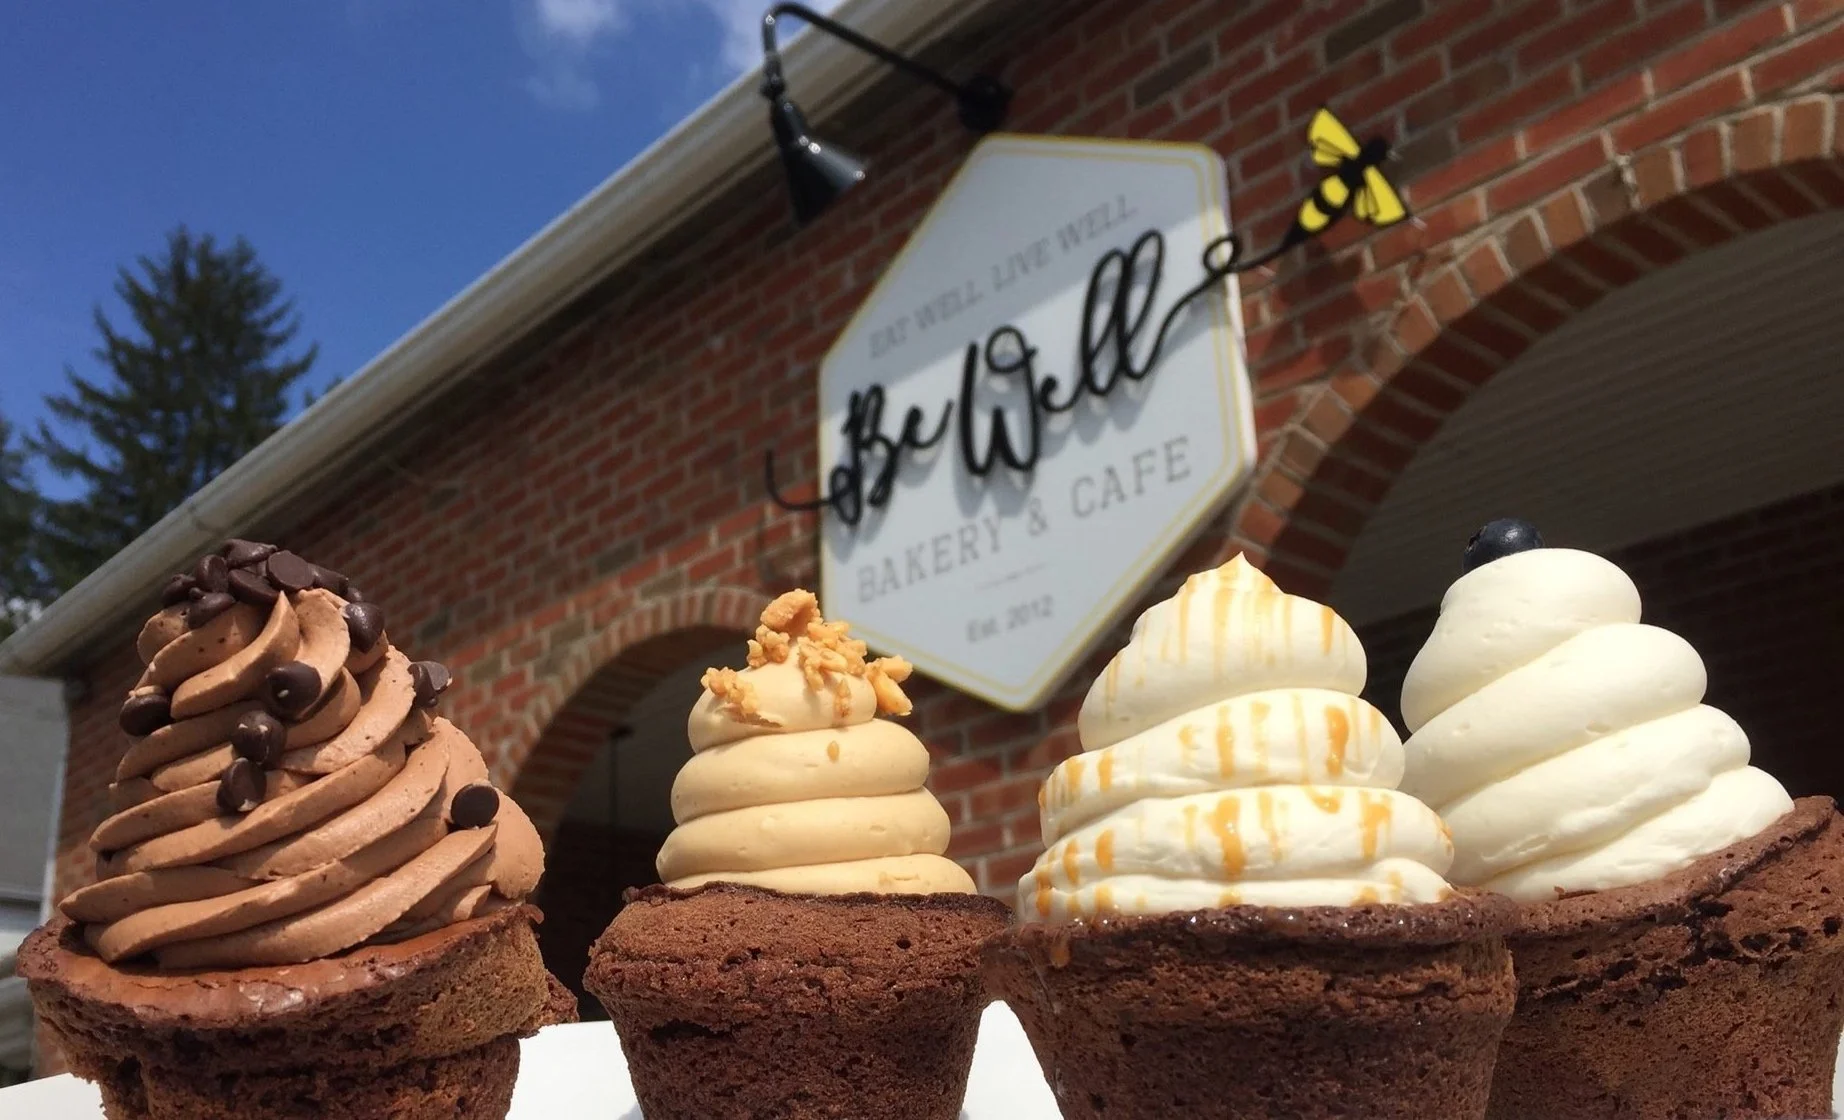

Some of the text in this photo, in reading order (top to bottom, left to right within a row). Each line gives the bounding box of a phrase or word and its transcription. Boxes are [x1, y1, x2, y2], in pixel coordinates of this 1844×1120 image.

[868, 194, 1138, 360] EAT WELL LIVE WELL
[820, 229, 1172, 526] Be Well
[857, 436, 1192, 604] BAKERY & CAFE
[1005, 594, 1055, 632] 2012
